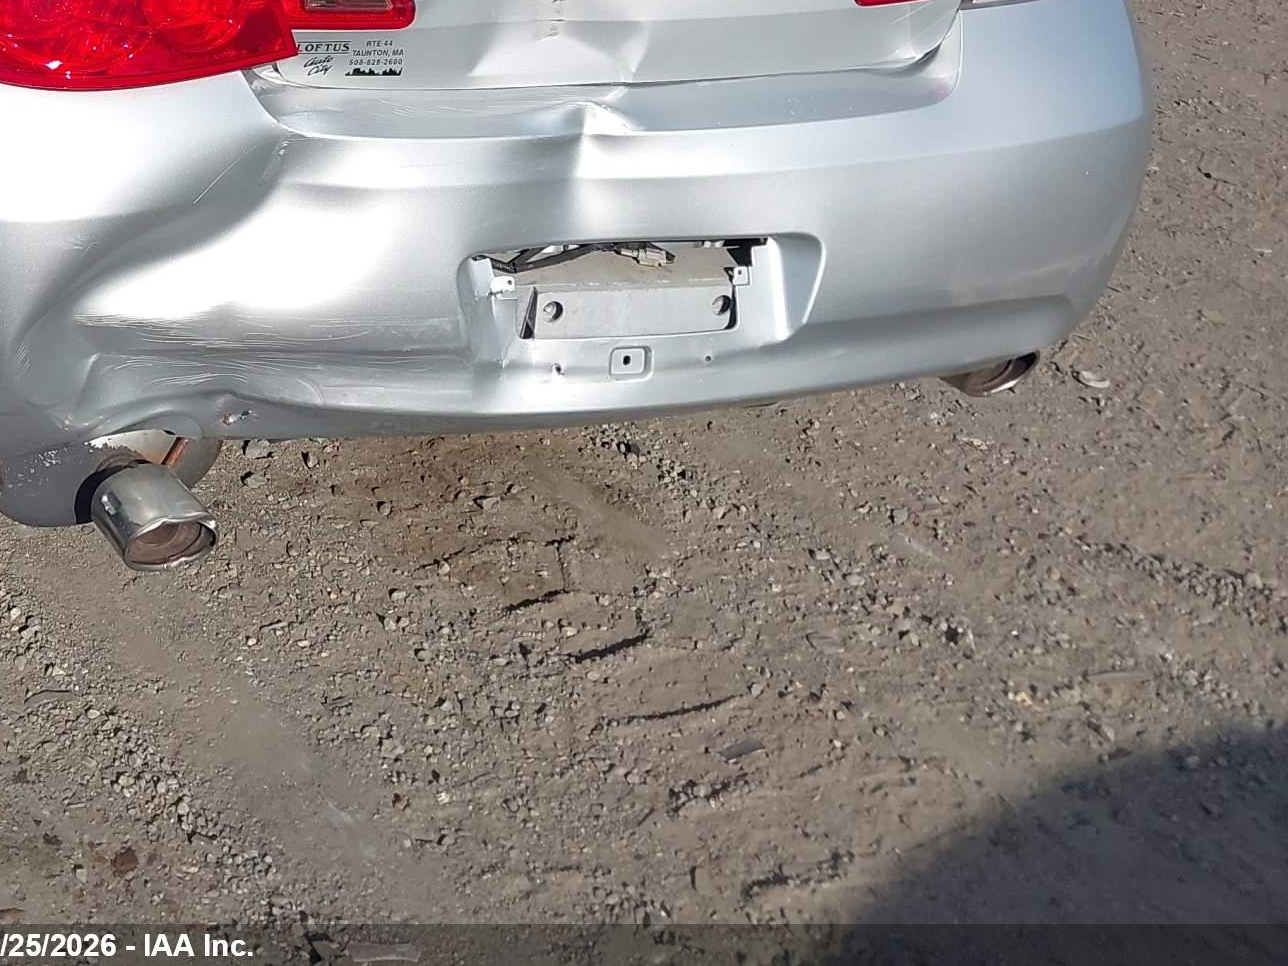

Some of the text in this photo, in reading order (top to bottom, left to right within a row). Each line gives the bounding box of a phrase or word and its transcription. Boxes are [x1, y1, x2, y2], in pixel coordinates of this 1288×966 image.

[297, 43, 350, 53] LOFTUS
[366, 40, 382, 48] RTE
[307, 64, 333, 76] City
